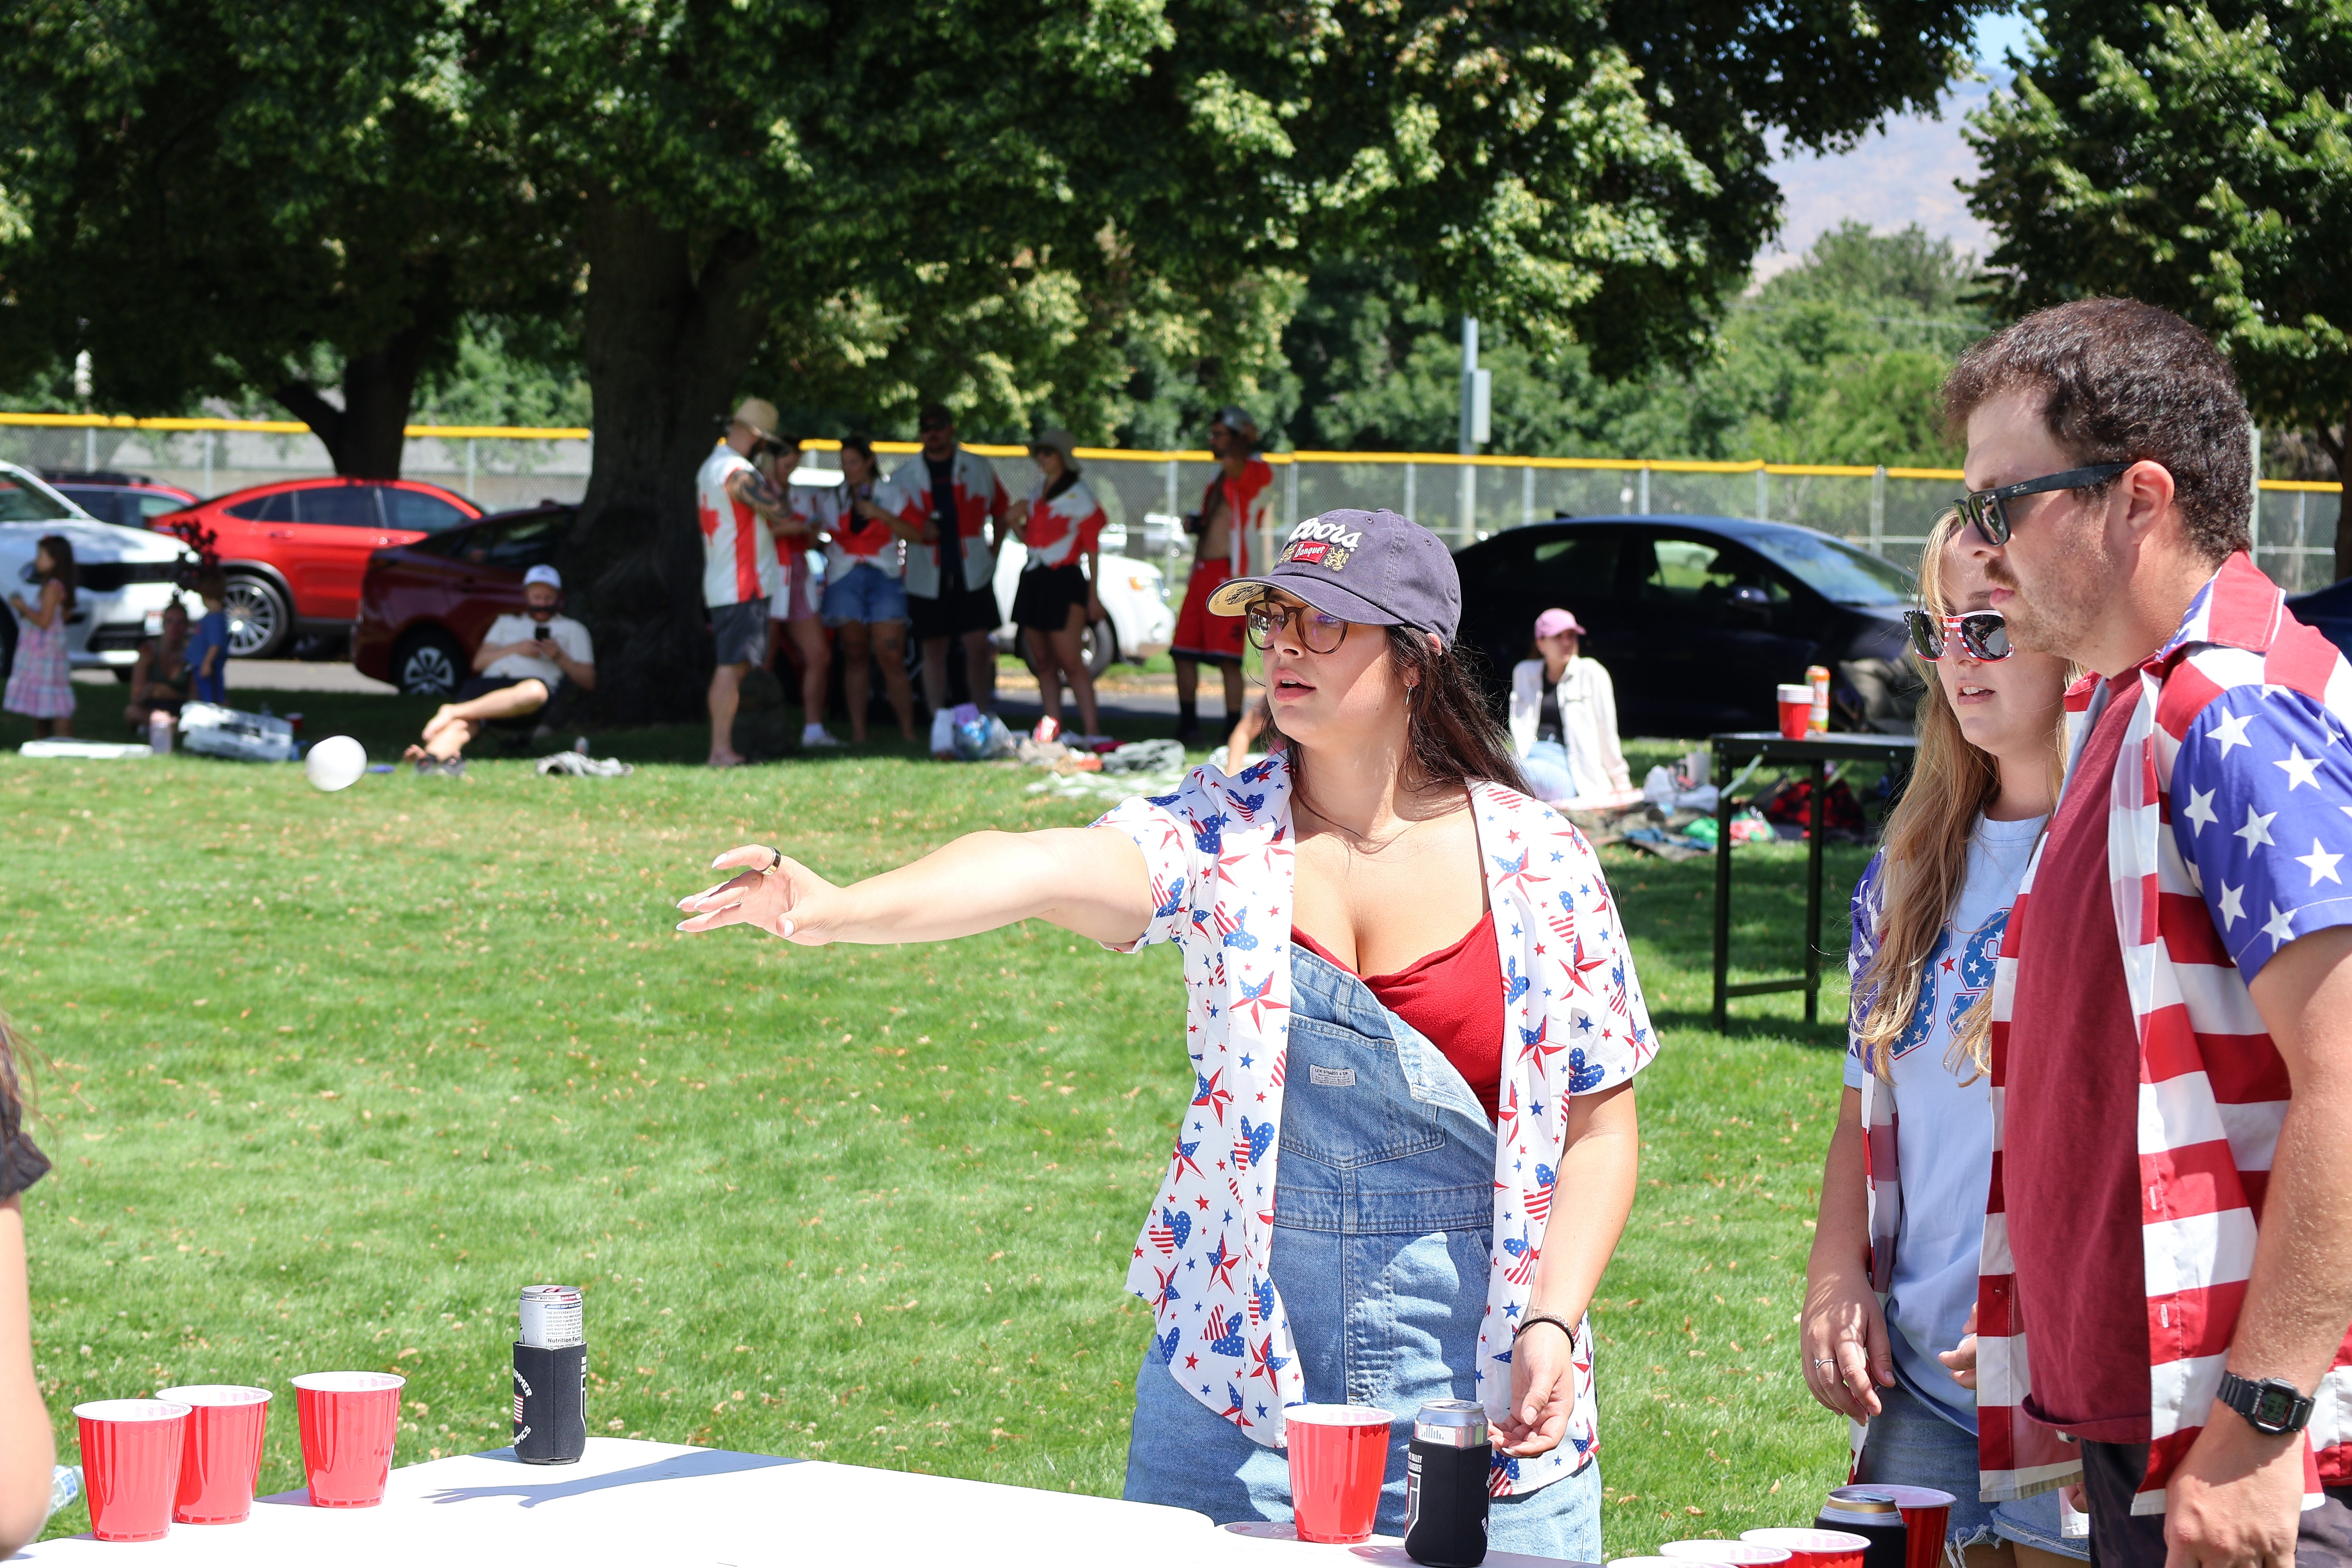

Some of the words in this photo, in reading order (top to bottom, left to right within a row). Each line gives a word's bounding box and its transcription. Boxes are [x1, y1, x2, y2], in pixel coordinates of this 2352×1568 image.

[1289, 517, 1362, 548] Coors
[1294, 543, 1326, 558] Banquet
[514, 1425, 531, 1445] MPICS
[1412, 1453, 1422, 1463] VALLEY
[1409, 1461, 1422, 1472] LEAGUES
